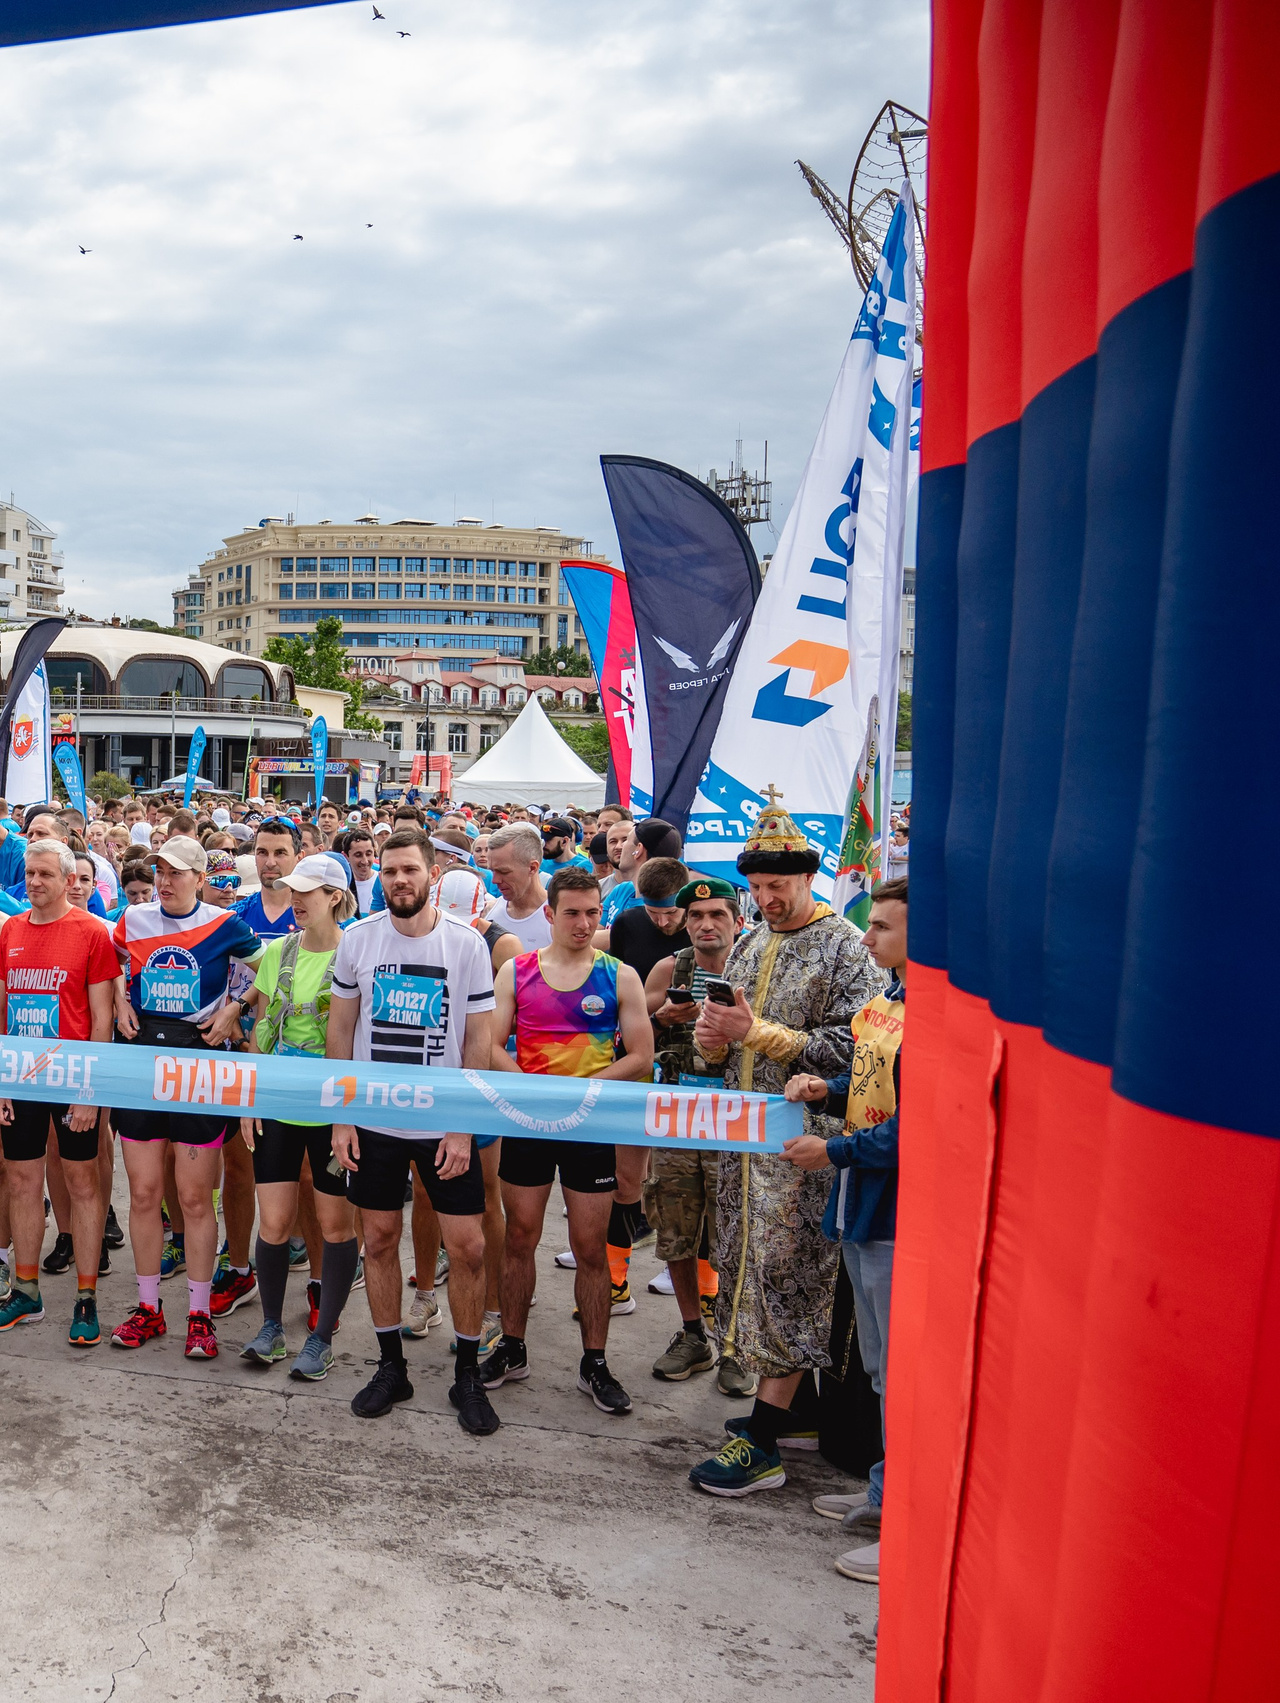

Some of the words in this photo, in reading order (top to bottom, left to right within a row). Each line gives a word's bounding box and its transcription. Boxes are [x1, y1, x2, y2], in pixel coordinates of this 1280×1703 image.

[149, 946, 195, 964] МОСРЕГИОНГАЗ
[7, 965, 68, 991] ФИНИШЁР
[150, 981, 190, 999] 40003
[386, 989, 428, 1011] 40127
[15, 1008, 48, 1024] 40108
[152, 1055, 257, 1107] СТАРТ
[365, 1081, 435, 1109] ПСБ
[494, 1097, 585, 1133] #САМОВЫРАЖЕНИЕ
[576, 1078, 604, 1118] #ГОРДОС
[644, 1090, 768, 1143] СТАРТ
